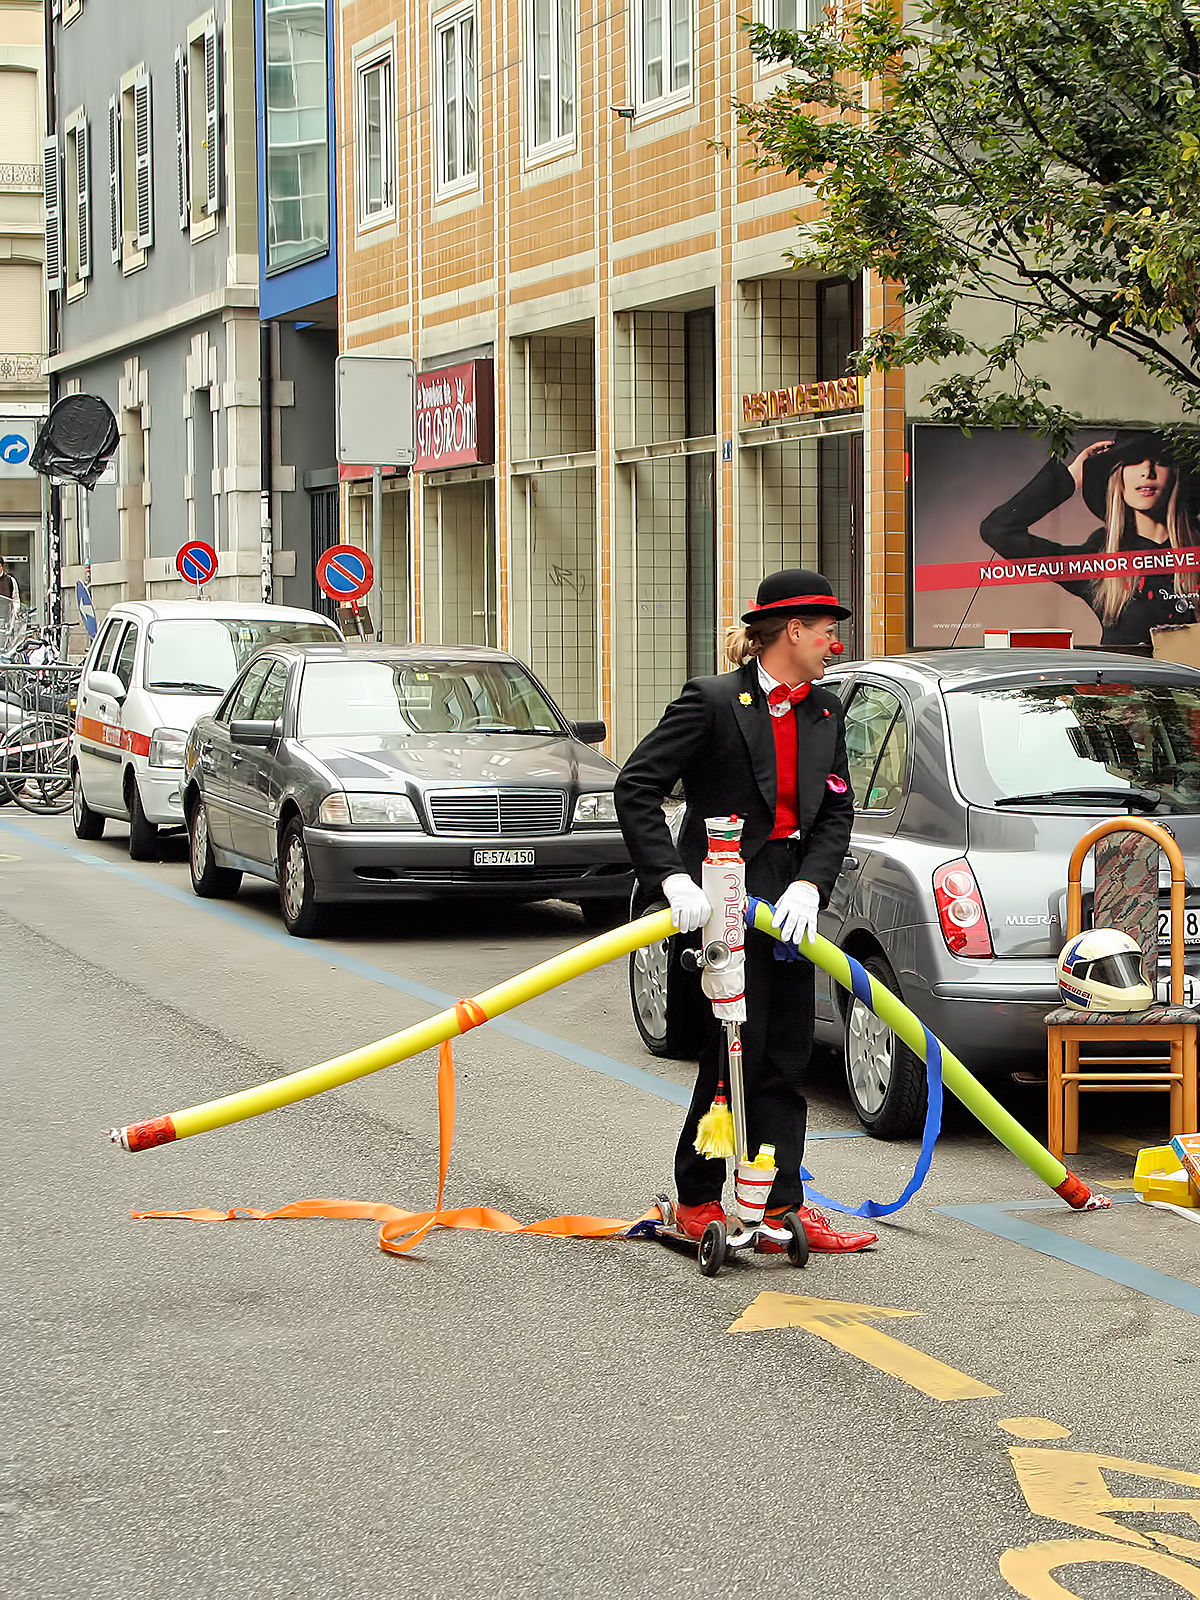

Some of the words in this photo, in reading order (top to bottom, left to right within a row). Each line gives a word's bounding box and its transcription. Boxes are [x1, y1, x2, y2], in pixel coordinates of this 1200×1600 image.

[743, 384, 814, 421] RESIDENCE
[817, 376, 859, 413] ROSSI
[979, 562, 1064, 580] NOUVEAU!
[1069, 557, 1128, 573] MANOR
[1132, 551, 1200, 570] GENÈVE.
[514, 850, 534, 863] 150
[1005, 914, 1058, 926] MICRA
